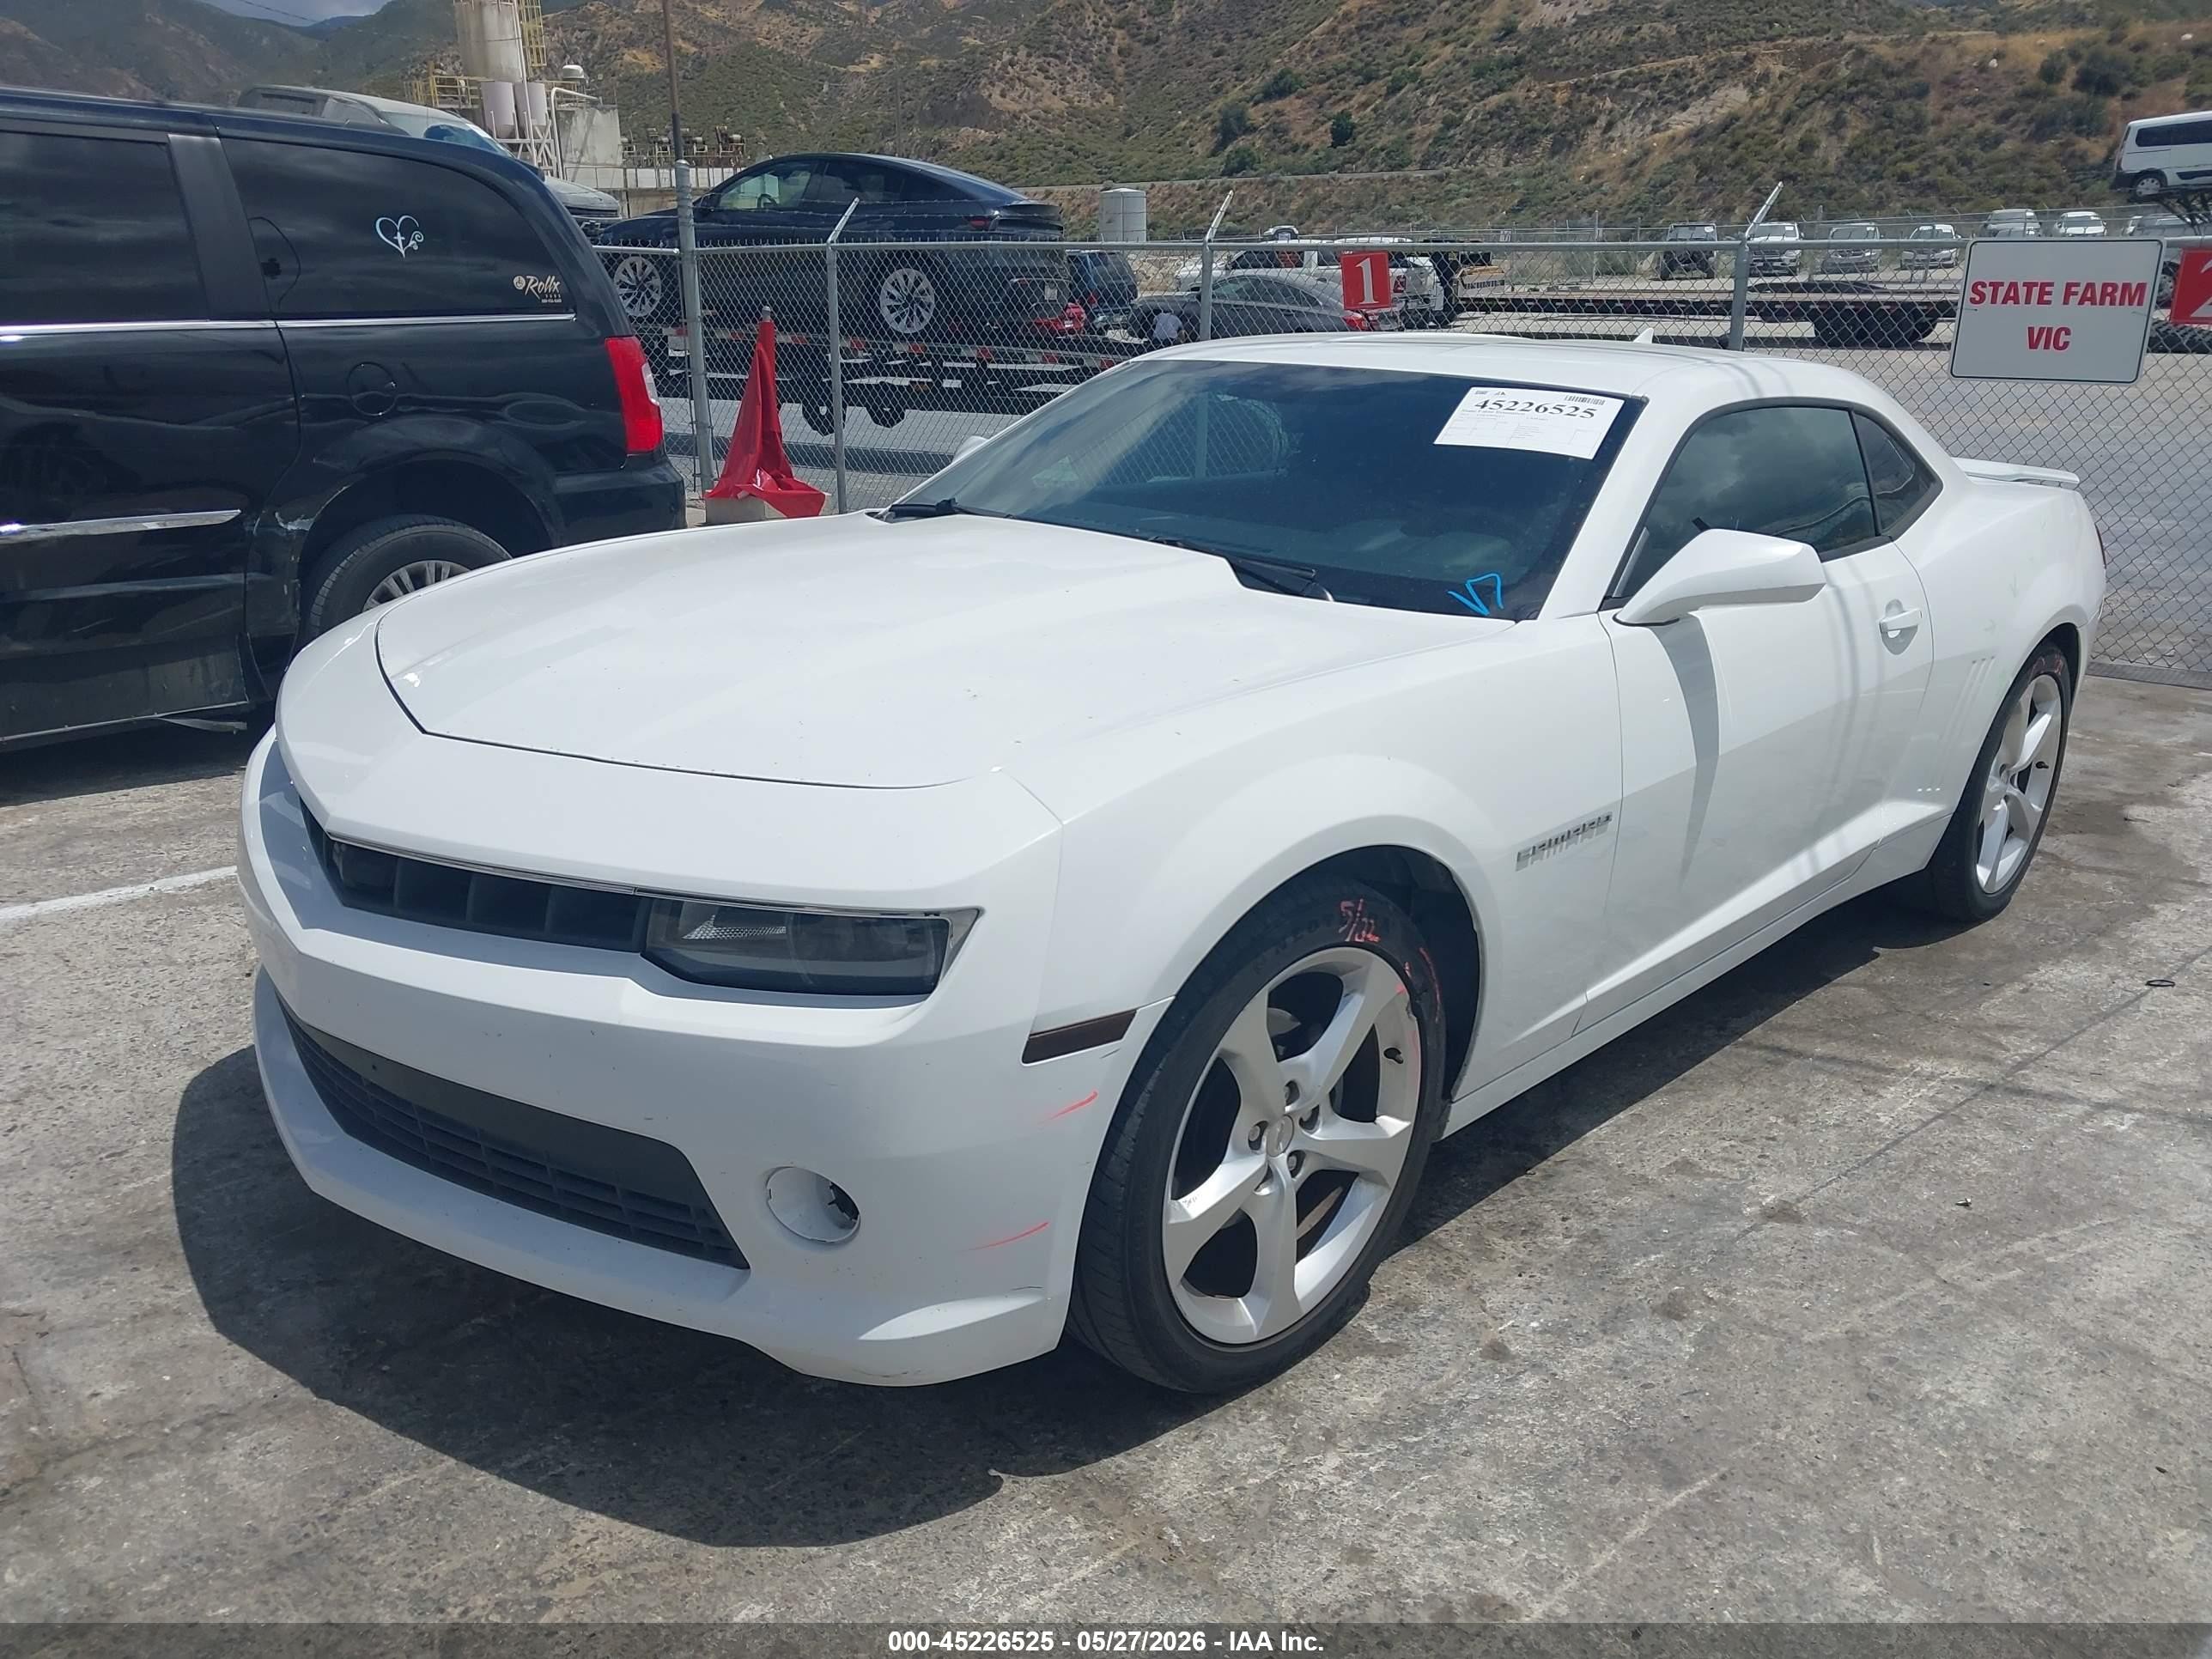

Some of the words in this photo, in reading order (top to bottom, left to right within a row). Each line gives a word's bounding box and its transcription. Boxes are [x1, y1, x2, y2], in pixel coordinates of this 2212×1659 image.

[525, 275, 561, 300] Rollx
[1355, 257, 1380, 305] 1
[1969, 281, 2055, 306] STATE
[2062, 282, 2148, 307] FARM
[2027, 325, 2072, 351] VIC
[1474, 398, 1597, 419] 45226525
